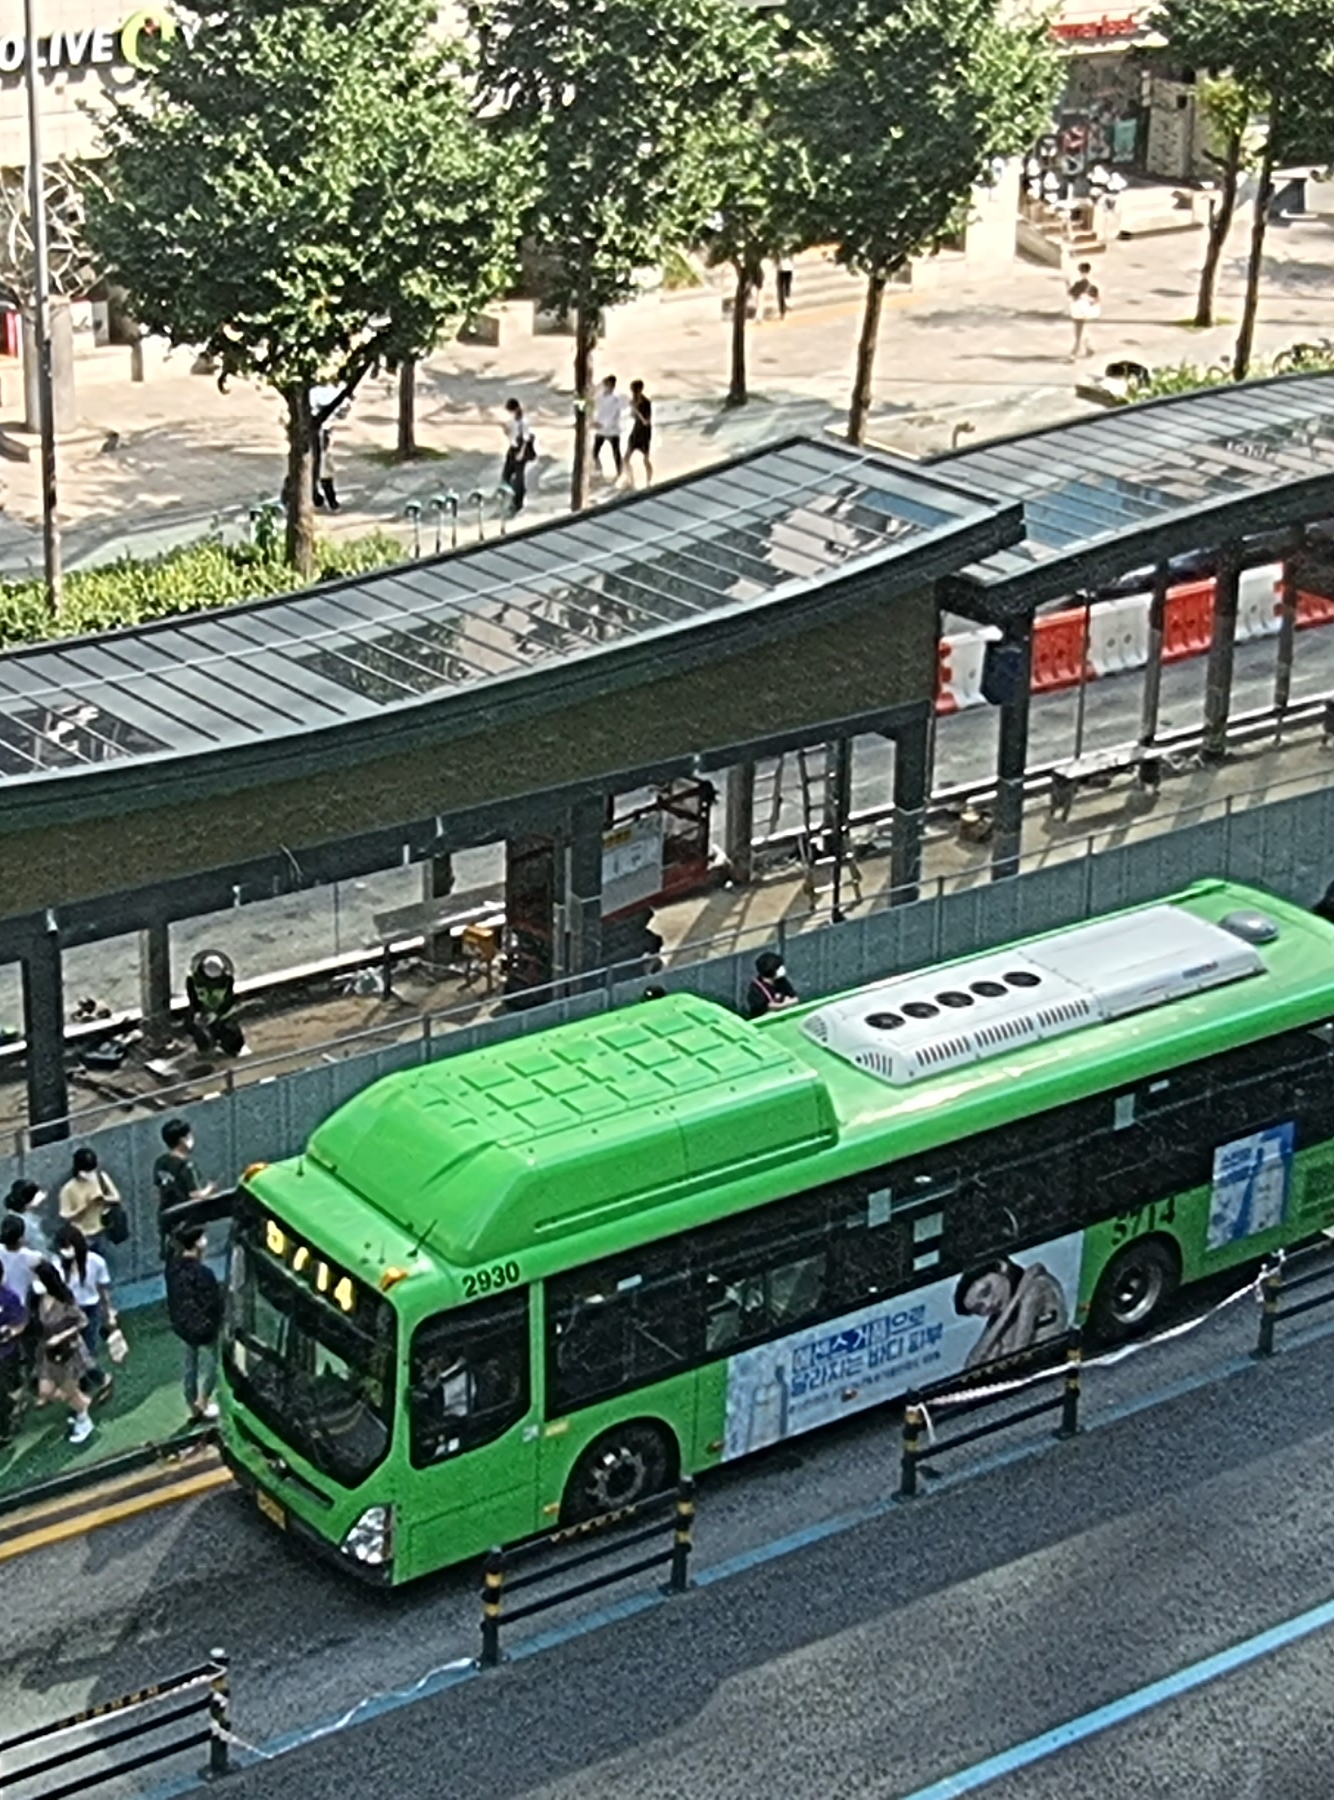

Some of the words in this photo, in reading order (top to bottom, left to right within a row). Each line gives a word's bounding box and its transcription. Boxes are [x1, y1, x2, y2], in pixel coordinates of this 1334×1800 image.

[1112, 1197, 1175, 1245] 5714
[461, 1260, 521, 1298] 2930
[868, 1337, 904, 1369] 바디
